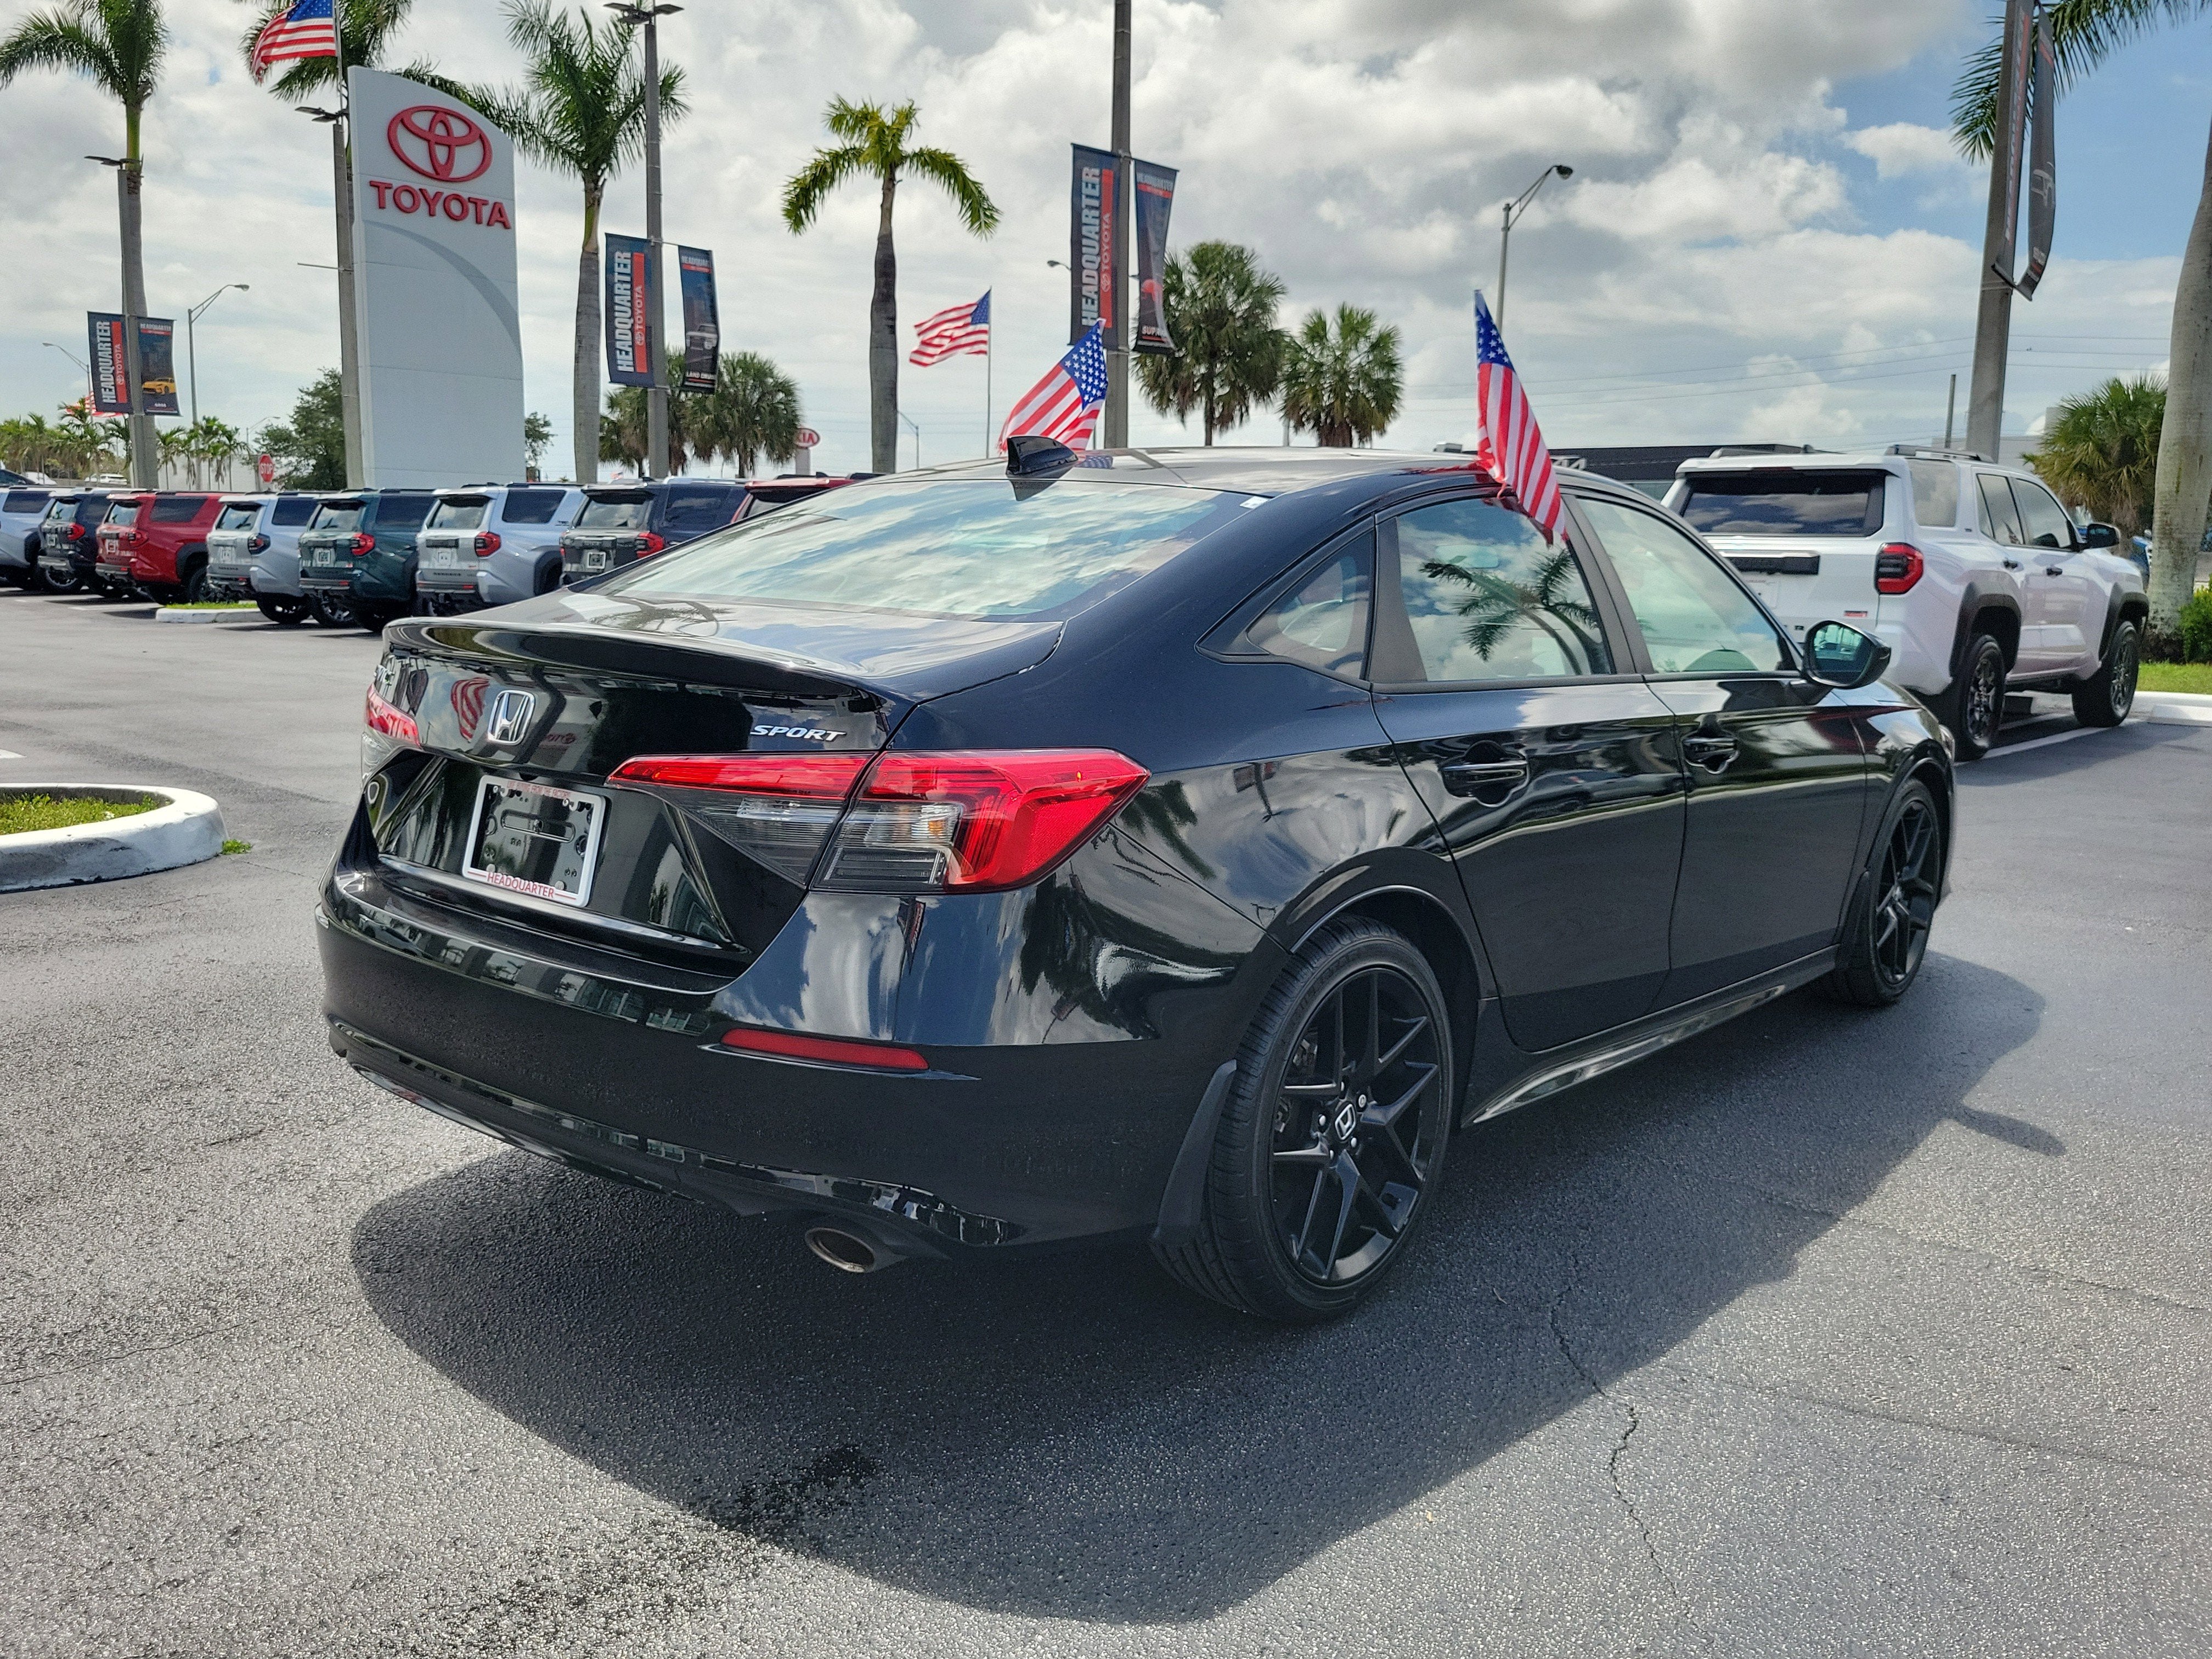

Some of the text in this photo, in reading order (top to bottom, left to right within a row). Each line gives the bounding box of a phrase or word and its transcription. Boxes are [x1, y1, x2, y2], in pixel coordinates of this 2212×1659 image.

[369, 180, 511, 229] TOYOTA
[1081, 166, 1101, 326] HEADQUARTER
[1102, 213, 1111, 270] TOYOTA
[614, 251, 634, 372] HEADQUARTER
[634, 285, 644, 330] TOYOTA
[97, 321, 116, 403] HEADQUARTER
[115, 343, 123, 376] TOYOTA
[260, 462, 273, 474] STOP
[750, 725, 847, 741] SPORT
[487, 872, 555, 898] HEADQUARTER
